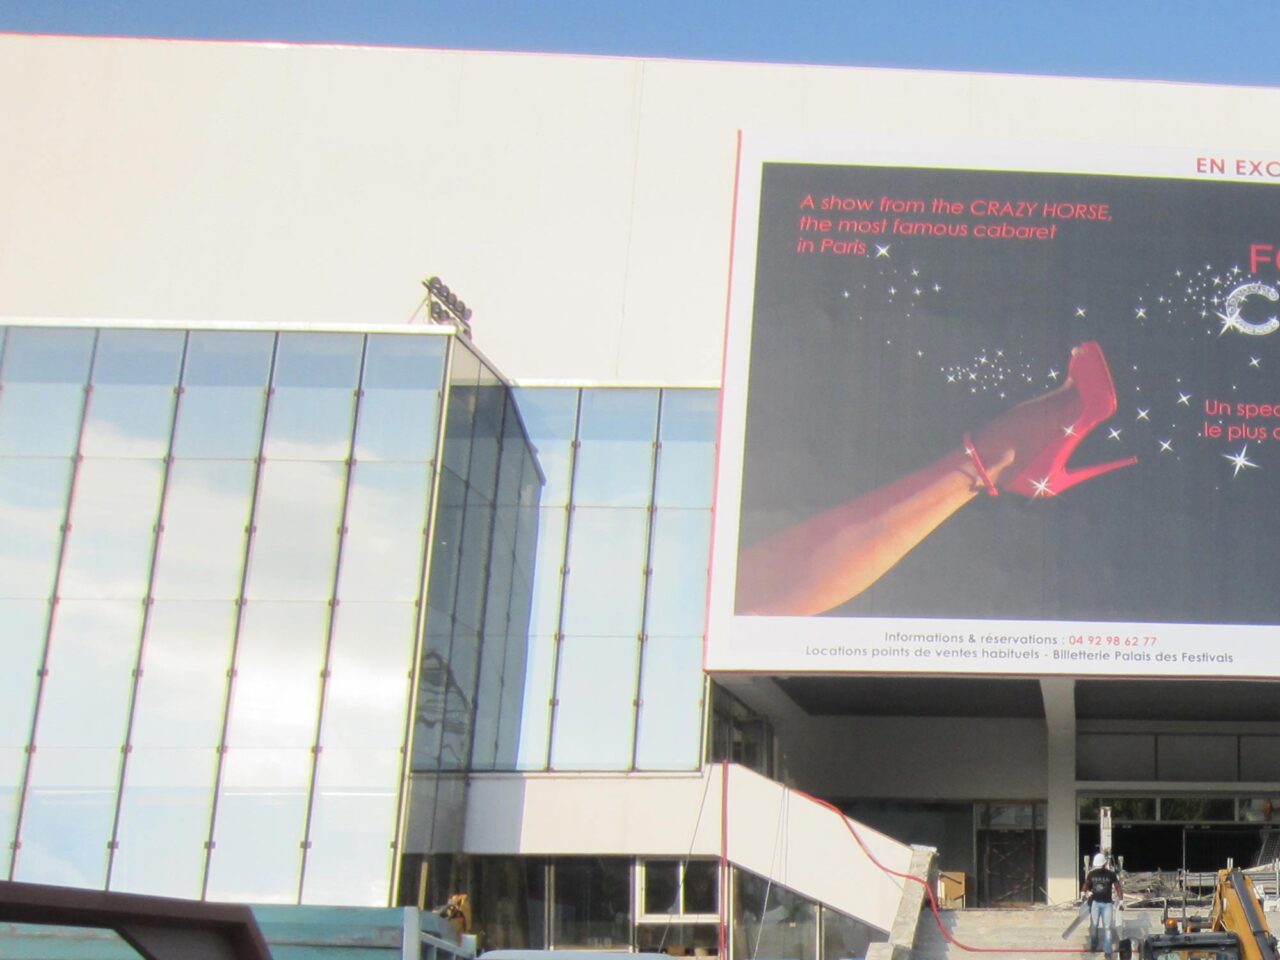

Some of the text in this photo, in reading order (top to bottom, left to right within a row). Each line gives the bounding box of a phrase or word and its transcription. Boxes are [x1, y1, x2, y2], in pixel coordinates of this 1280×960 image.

[1197, 157, 1225, 174] EN
[800, 195, 816, 210] A
[821, 195, 873, 212] show
[880, 196, 925, 214] from
[931, 198, 964, 215] the
[970, 200, 1039, 218] CRAZY
[800, 216, 1057, 240] the most famous cabaret
[797, 238, 866, 256] in Paris
[1205, 399, 1232, 416] Un
[1204, 422, 1221, 438] le
[1228, 423, 1267, 443] plus
[885, 631, 964, 645] Informations
[968, 633, 977, 644] &
[980, 632, 1057, 646] réservations
[1069, 634, 1083, 646] 04
[1088, 635, 1102, 646] 92
[1106, 635, 1121, 647] 98
[1124, 636, 1139, 647] 62
[1143, 636, 1157, 647] 77
[806, 645, 868, 658] Locations
[871, 646, 909, 660] points
[913, 647, 931, 658] de
[935, 648, 977, 659] ventes
[981, 647, 1040, 660] habituels
[1053, 649, 1110, 662] Billetterie
[1115, 650, 1151, 663] Palais
[1155, 651, 1177, 663] des
[1181, 651, 1234, 664] Festivals
